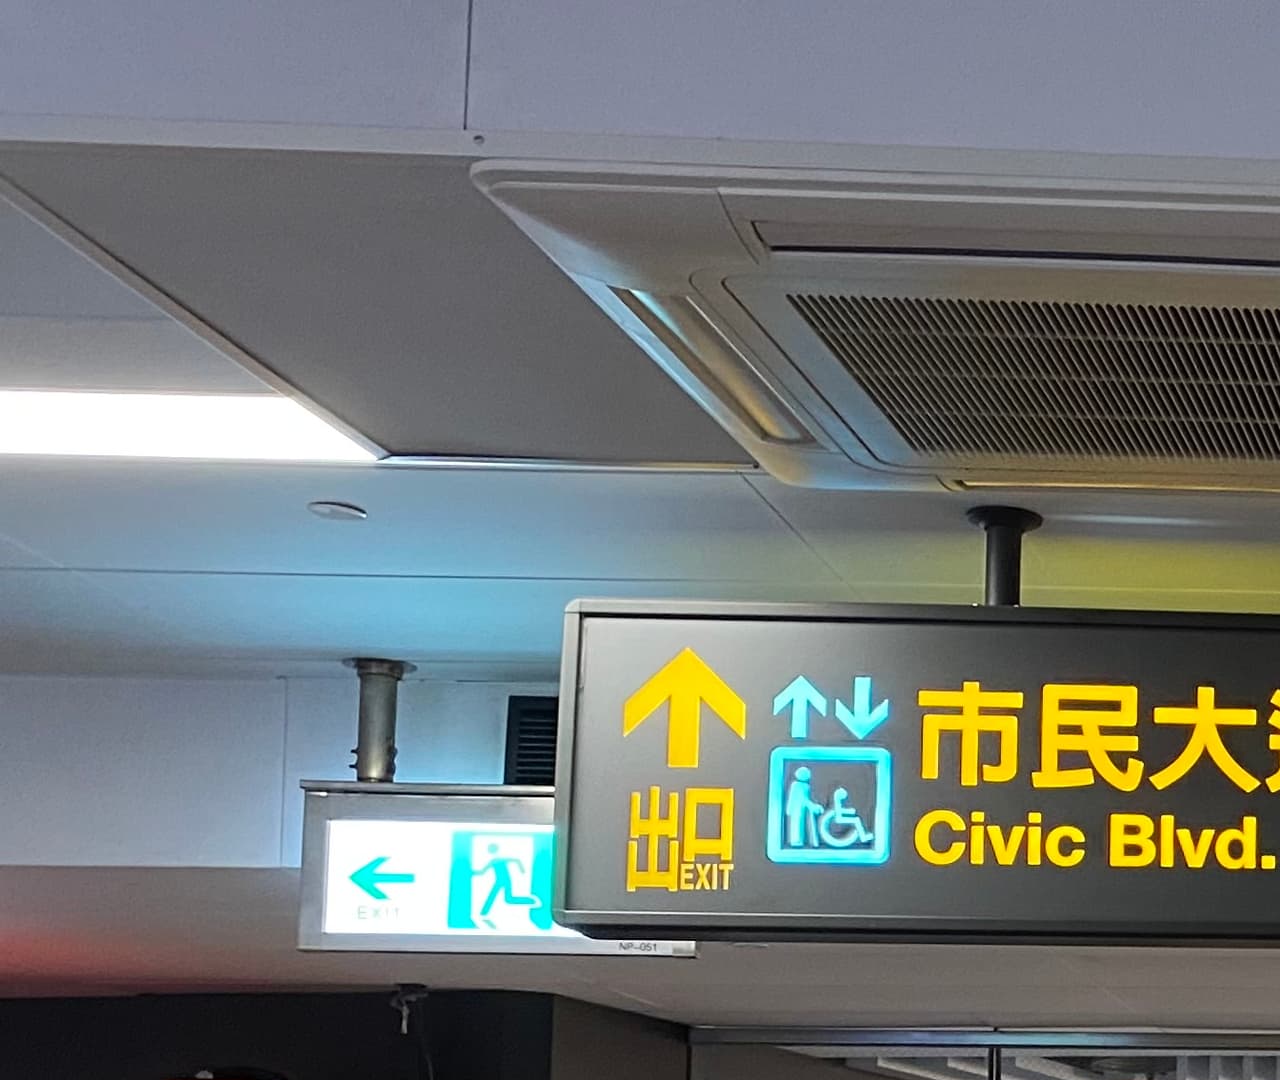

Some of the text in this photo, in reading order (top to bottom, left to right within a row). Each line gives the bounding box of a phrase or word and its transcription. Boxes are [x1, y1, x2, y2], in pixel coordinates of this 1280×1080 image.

[626, 785, 736, 893] 出口
[914, 810, 1278, 870] Civic Blvd.
[680, 862, 735, 892] EXIT
